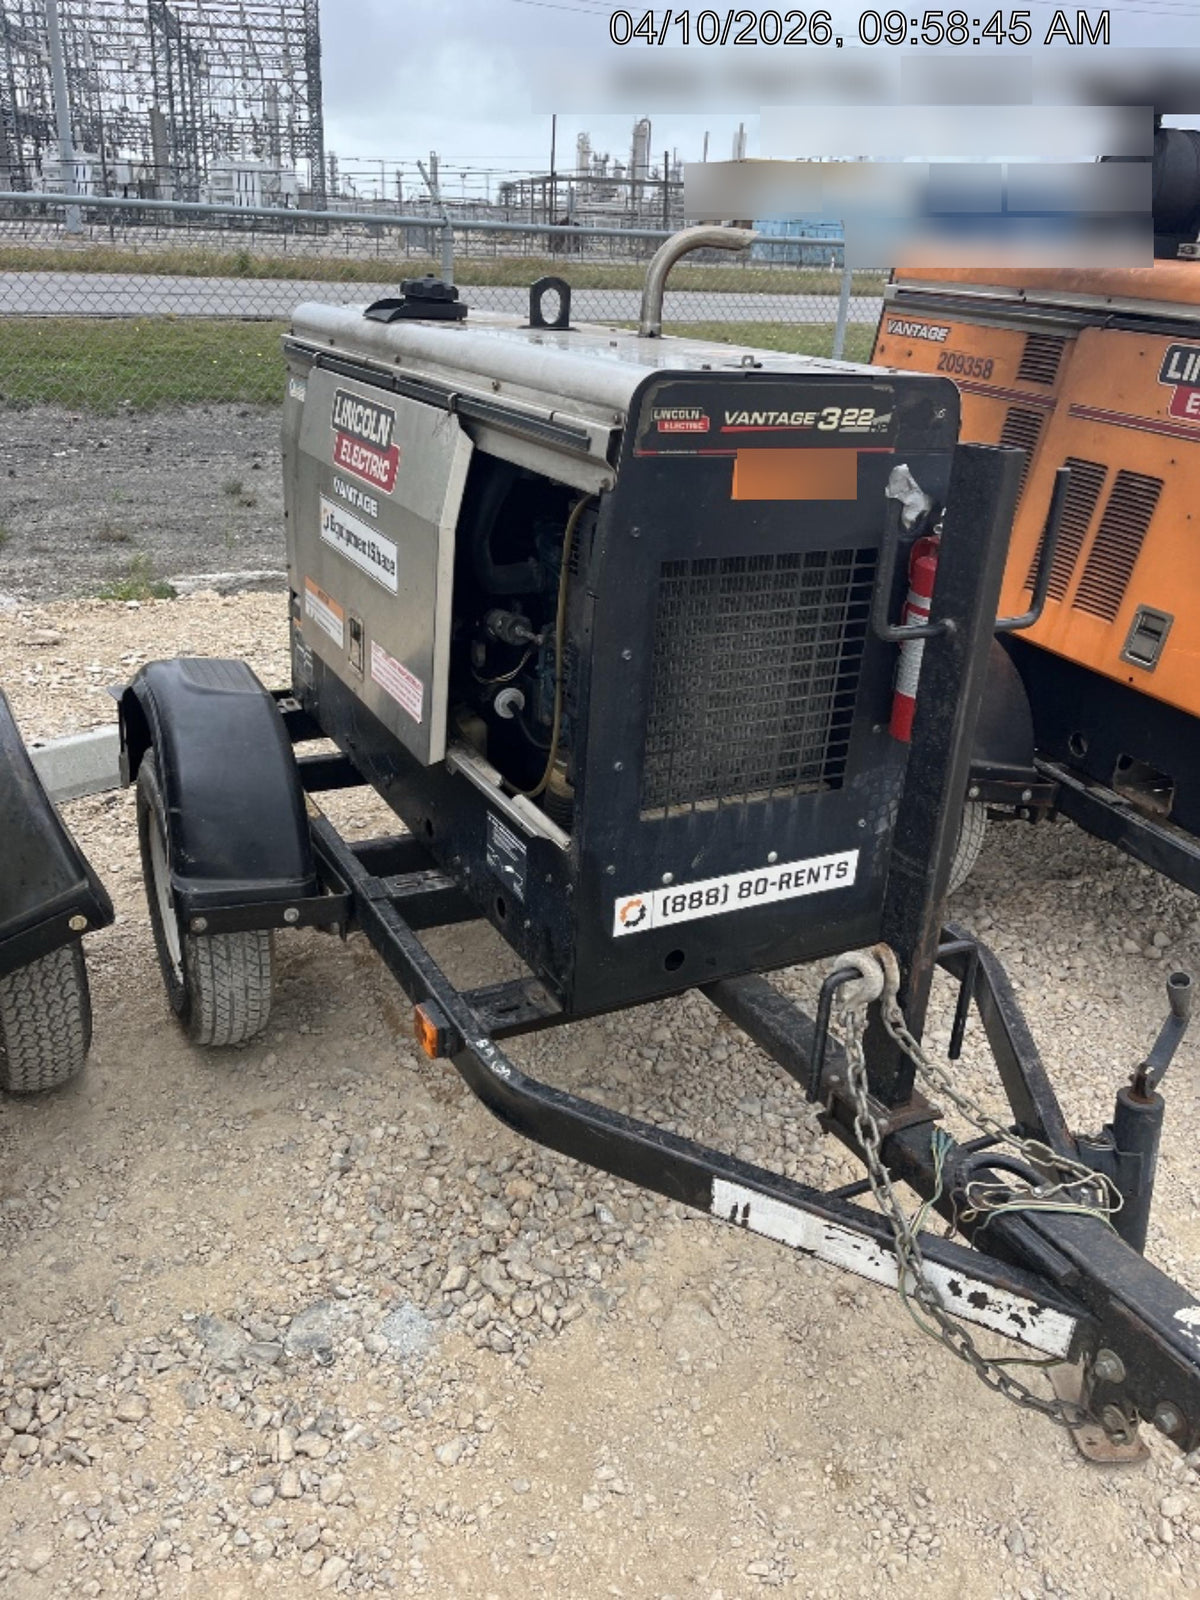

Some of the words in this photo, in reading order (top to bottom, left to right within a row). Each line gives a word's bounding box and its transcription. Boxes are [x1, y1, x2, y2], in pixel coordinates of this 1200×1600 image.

[887, 319, 950, 343] VANTAGE
[937, 350, 995, 381] 209358
[333, 394, 392, 448] LINCOLN
[653, 409, 700, 421] LINCOLN
[723, 409, 818, 426] VANTAGE
[817, 406, 876, 432] 322
[340, 437, 391, 483] ELECTRIC
[333, 475, 379, 518] VANTAGE
[329, 512, 396, 577] EquipmentShare
[661, 883, 730, 918] (888)
[736, 860, 850, 899] 80-RENTS
